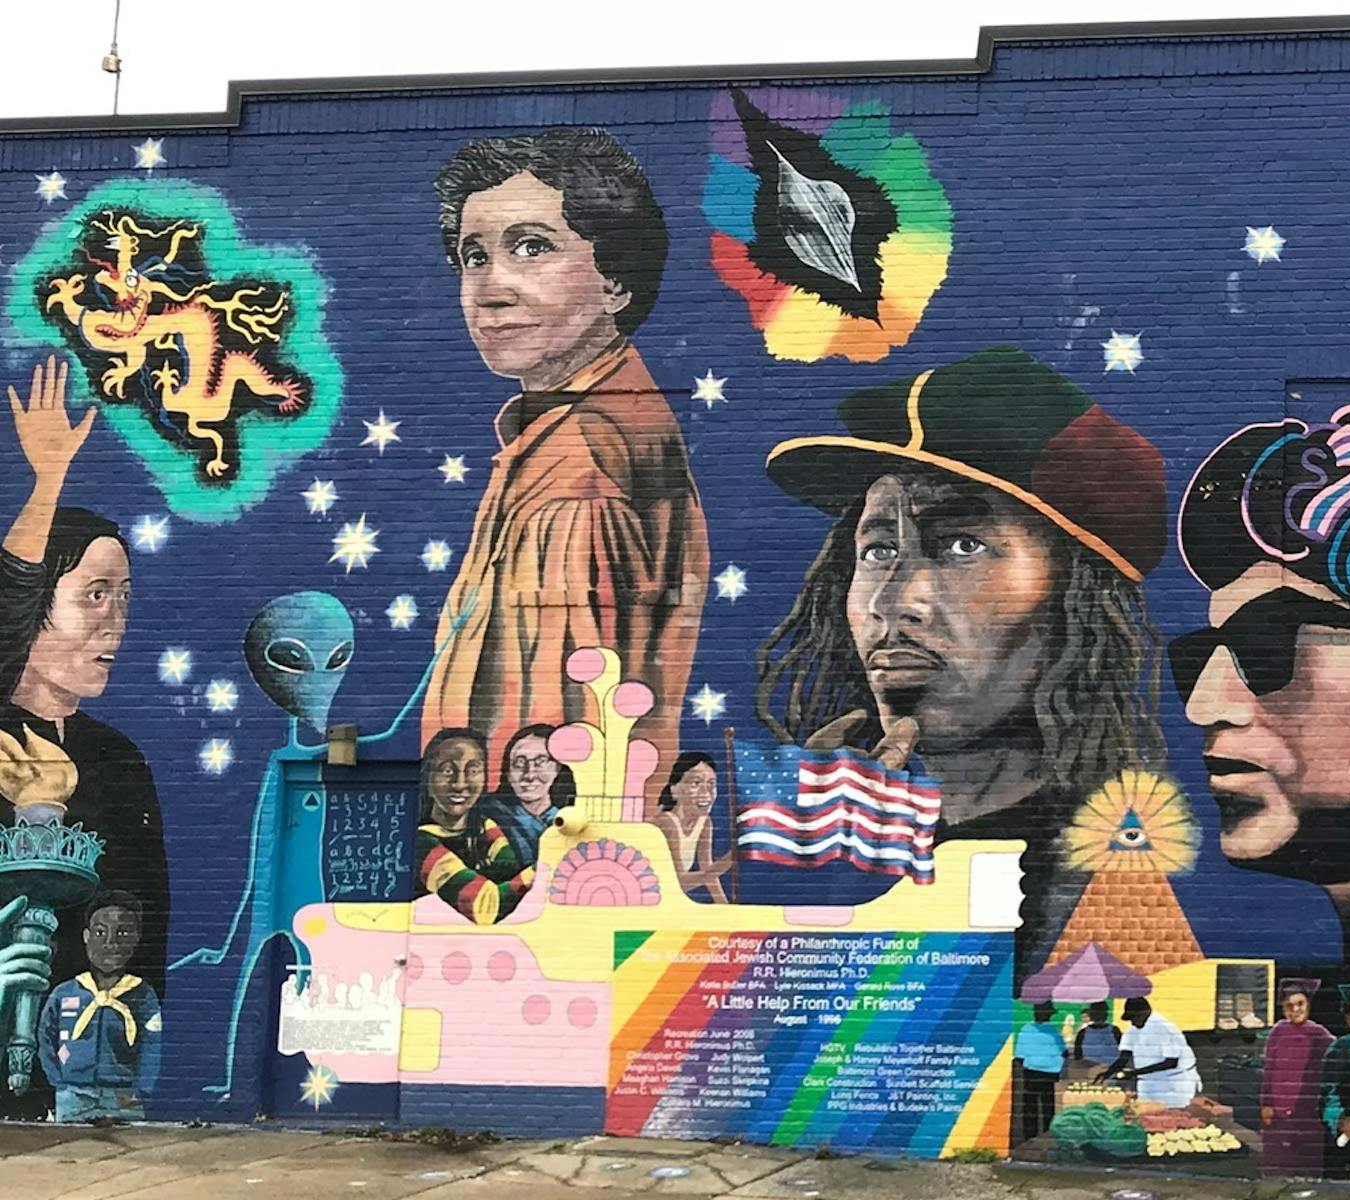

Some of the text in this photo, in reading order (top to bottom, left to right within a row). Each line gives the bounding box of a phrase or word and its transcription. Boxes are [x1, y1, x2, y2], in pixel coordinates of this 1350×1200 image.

[344, 819, 353, 831] 2
[358, 817, 366, 830] 3
[370, 818, 379, 829] 4
[390, 816, 399, 829] 5
[343, 872, 351, 883] 2
[355, 872, 364, 884] 3
[370, 872, 379, 885] 4
[708, 936, 919, 951] Courtesy of a Philanthropic Fund of
[733, 951, 774, 964] Jewish
[777, 952, 846, 967] Community
[849, 952, 914, 965] Federation
[917, 952, 929, 965] of
[931, 952, 991, 966] Baltimore
[754, 967, 870, 978] R.R. Hieronimus Ph.D.
[721, 995, 754, 1009] Little
[758, 995, 790, 1012] Help
[793, 996, 829, 1010] From
[834, 996, 860, 1010] Our
[863, 996, 922, 1011] Friends"
[774, 1015, 808, 1026] August
[953, 1080, 988, 1090] Servic
